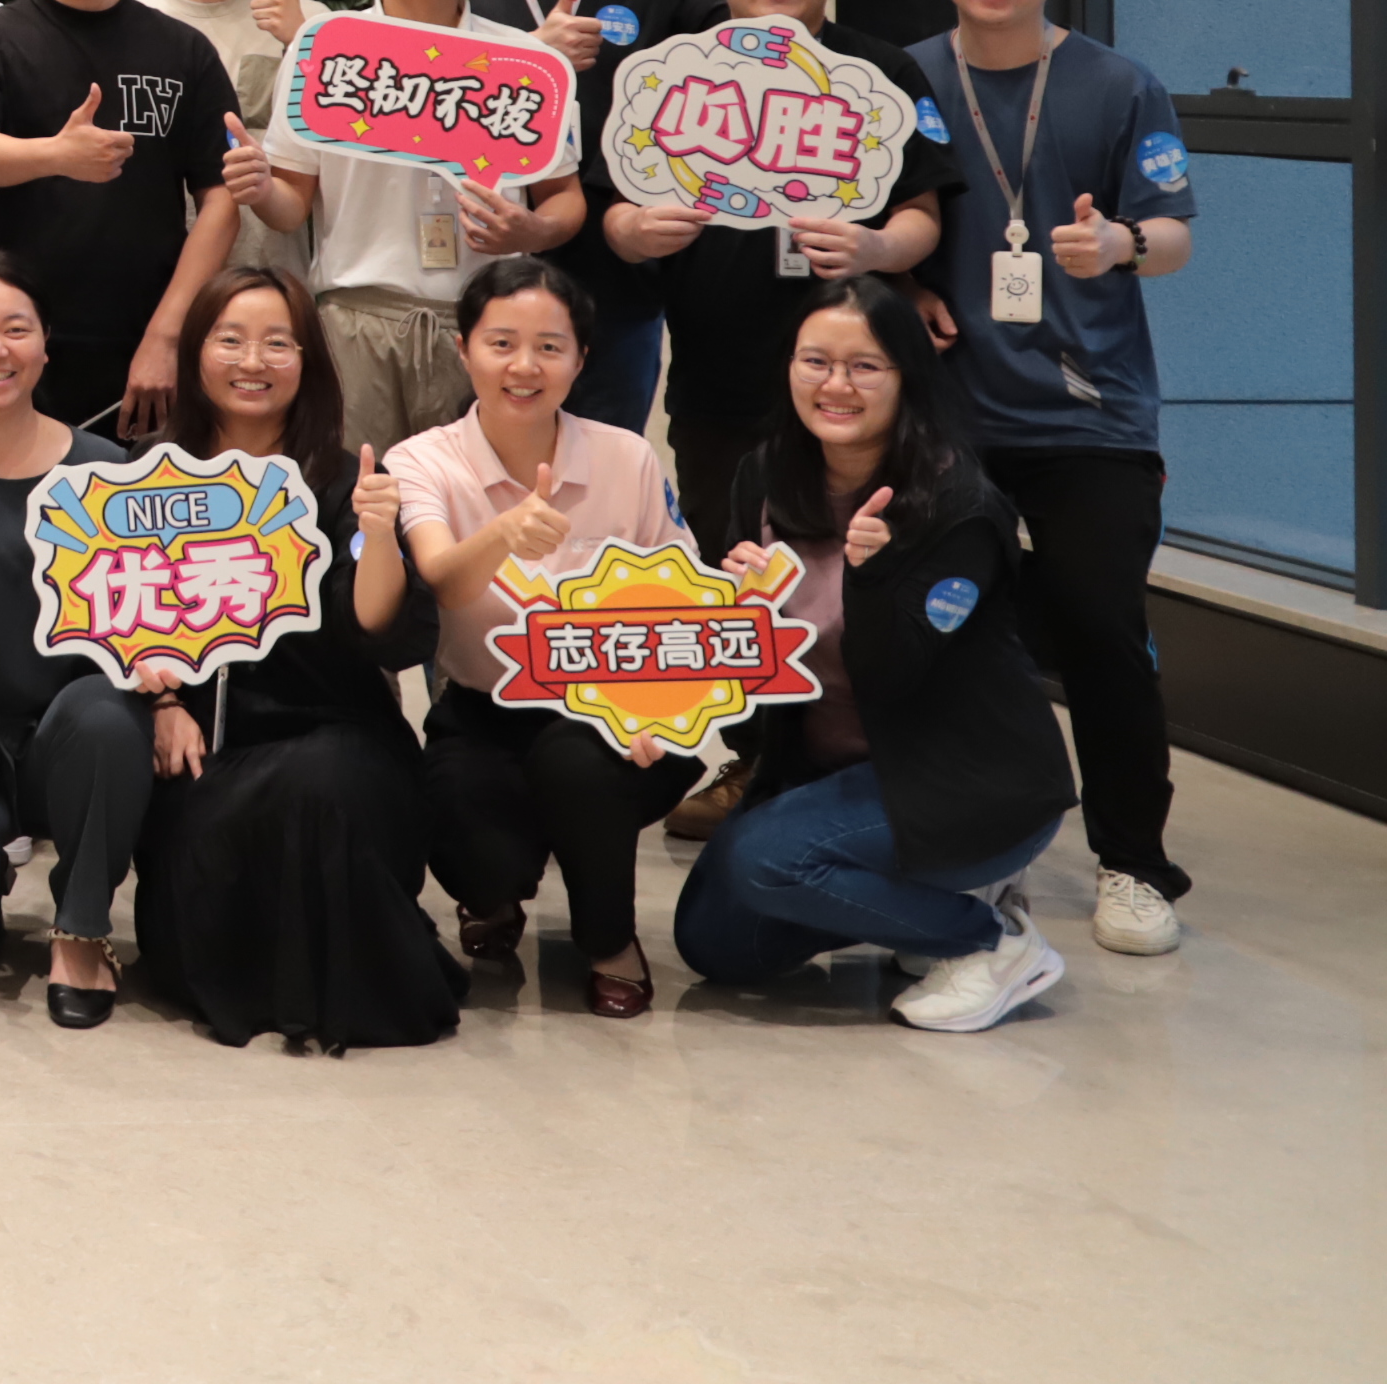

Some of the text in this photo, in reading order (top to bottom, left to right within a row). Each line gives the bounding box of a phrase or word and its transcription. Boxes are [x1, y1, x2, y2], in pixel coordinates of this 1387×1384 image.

[315, 53, 544, 145] 坚韧不拔
[651, 75, 864, 180] 必胜
[125, 491, 210, 532] NICE
[69, 534, 278, 638] 优秀
[543, 618, 762, 673] 志存高远
